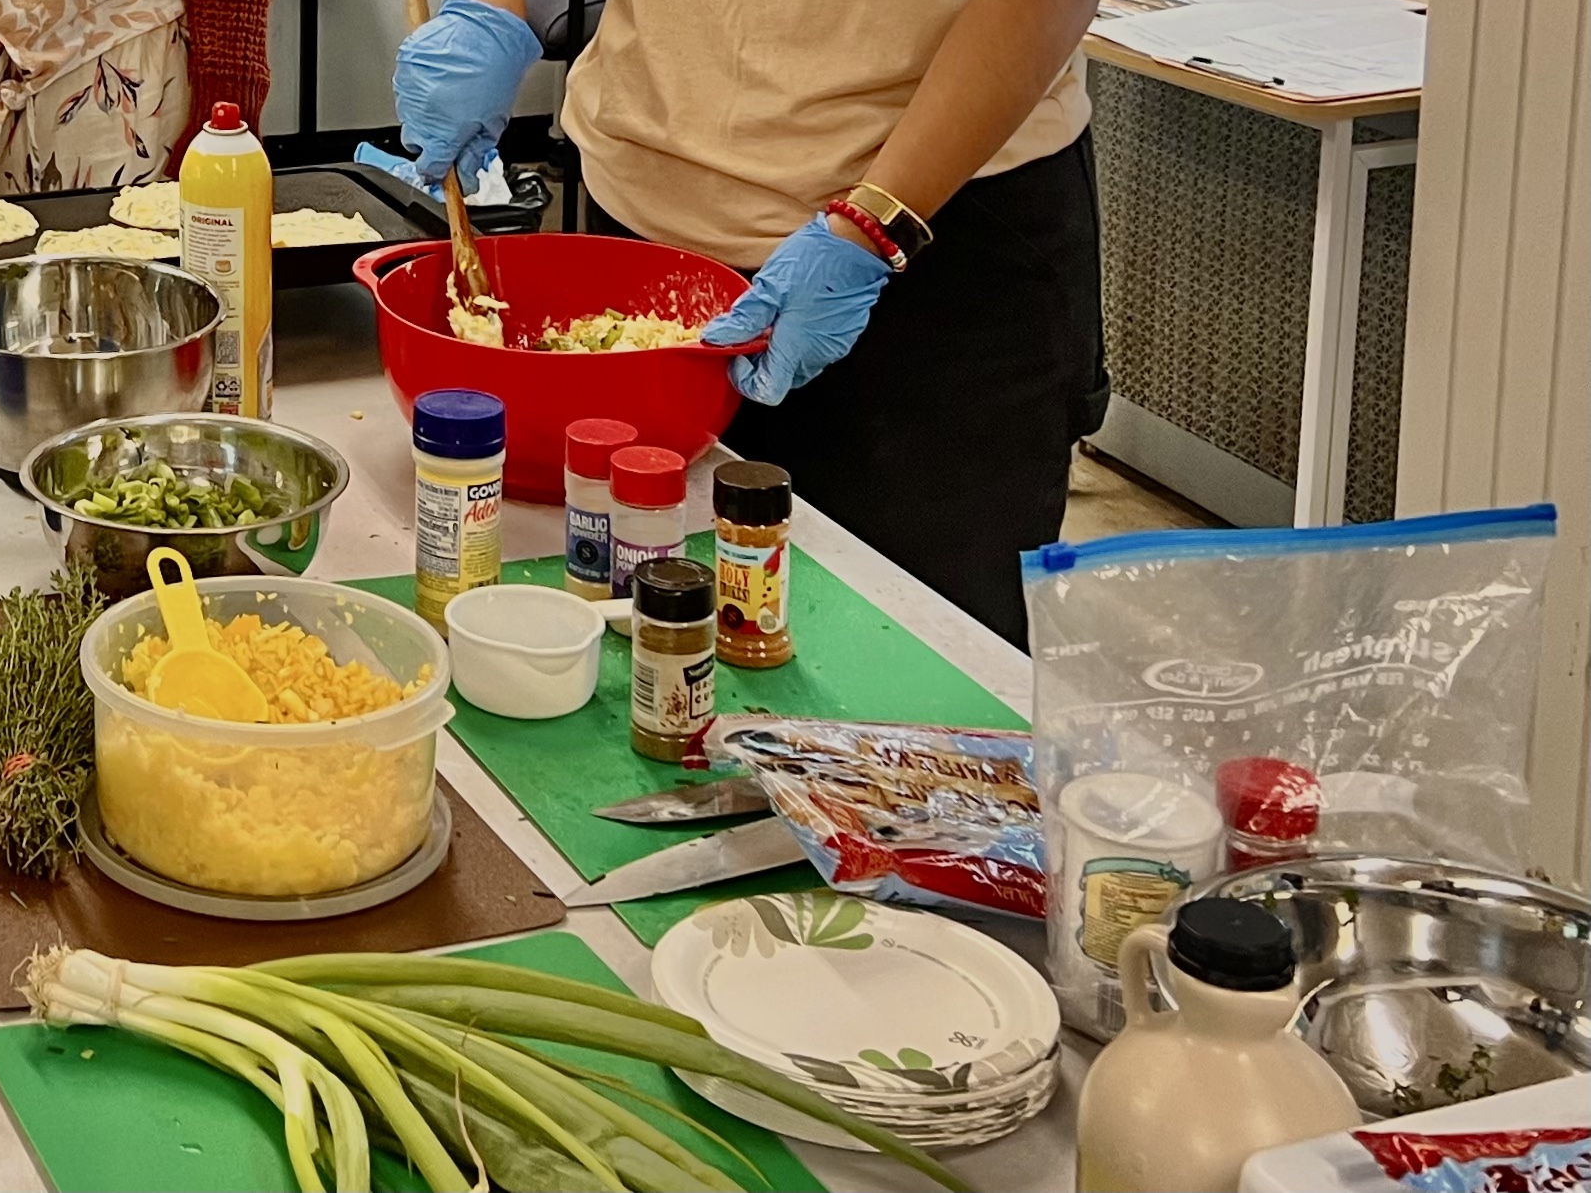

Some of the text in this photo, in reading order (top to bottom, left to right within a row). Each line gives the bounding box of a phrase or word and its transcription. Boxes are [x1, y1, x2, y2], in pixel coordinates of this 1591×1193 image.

[191, 215, 234, 227] ORIGINAL
[569, 511, 608, 533] GARLIC
[569, 525, 608, 544] POWDER
